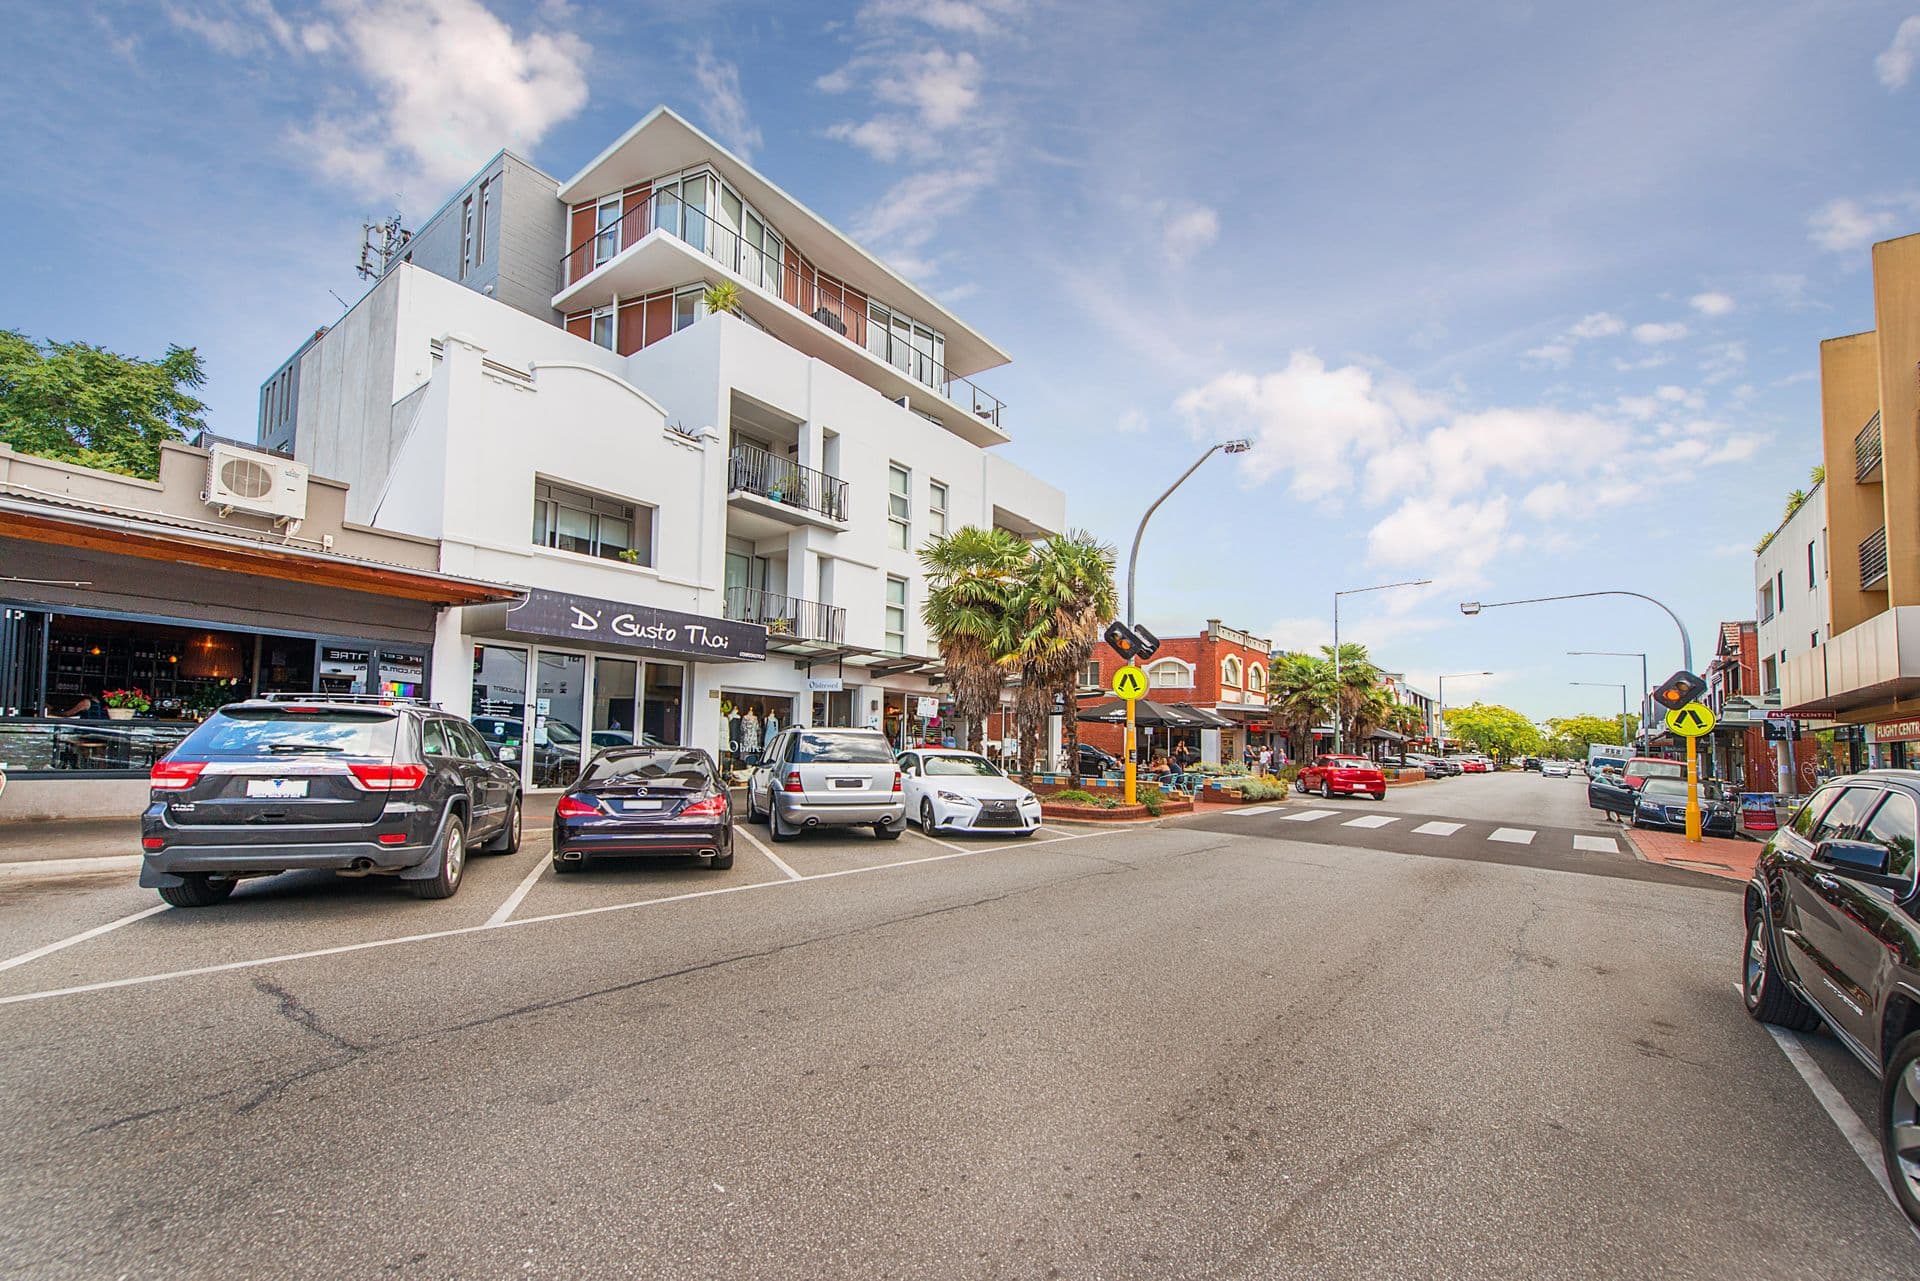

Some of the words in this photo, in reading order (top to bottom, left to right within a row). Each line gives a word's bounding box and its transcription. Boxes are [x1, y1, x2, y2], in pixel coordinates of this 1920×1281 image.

[570, 607, 602, 630] D'
[611, 614, 676, 641] Gusto
[684, 625, 729, 648] Thai
[1877, 725, 1898, 738] FLIGHT
[1898, 721, 1920, 736] CENTR
[729, 740, 767, 753] Obdres
